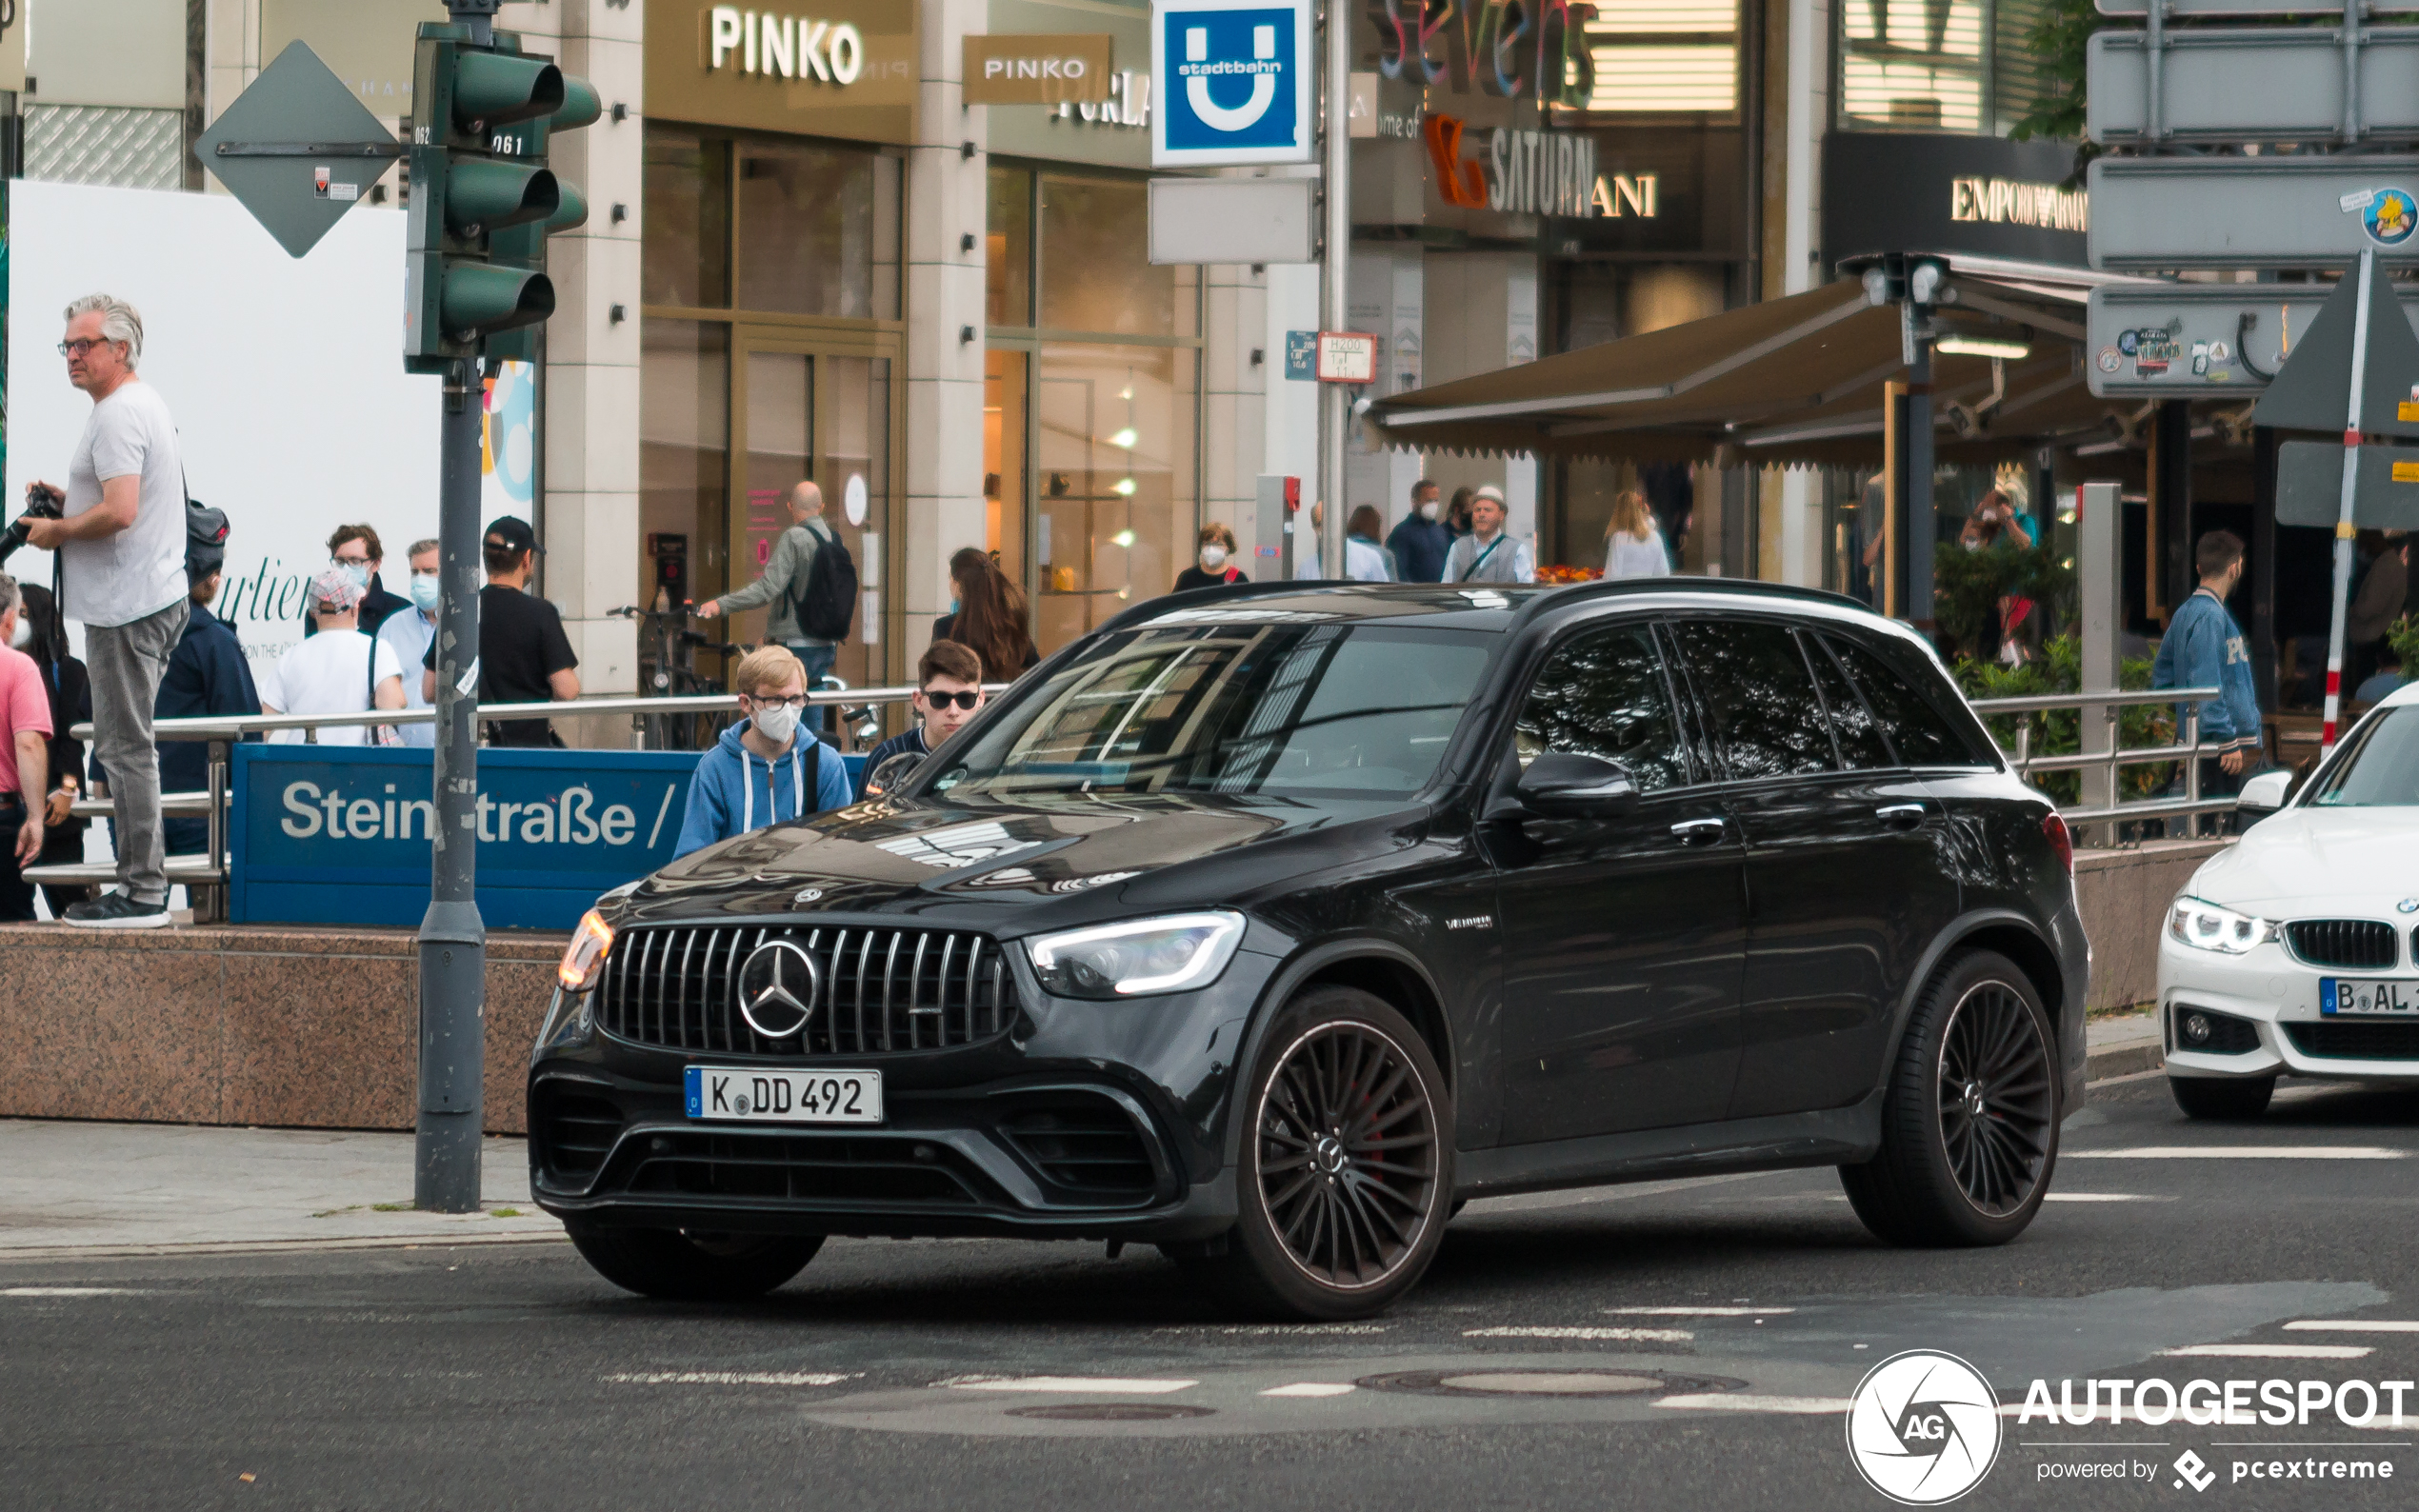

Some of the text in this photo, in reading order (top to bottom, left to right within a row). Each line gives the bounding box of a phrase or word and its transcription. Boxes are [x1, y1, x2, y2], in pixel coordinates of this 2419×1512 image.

[711, 6, 861, 85] PINKO
[985, 59, 1085, 79] PINKO
[1178, 60, 1282, 75] stadtbahn
[414, 127, 430, 145] 062
[493, 134, 523, 155] 061
[1490, 127, 1594, 218] SATURN
[1951, 178, 2038, 226] EMPORIO
[1330, 339, 1361, 351] H200
[261, 644, 277, 659] THE
[280, 780, 636, 846] Steintraße
[2337, 983, 2355, 1009] B
[2373, 984, 2409, 1010] AL
[712, 1076, 730, 1112] K
[752, 1077, 791, 1114] DD
[801, 1078, 863, 1115] 492
